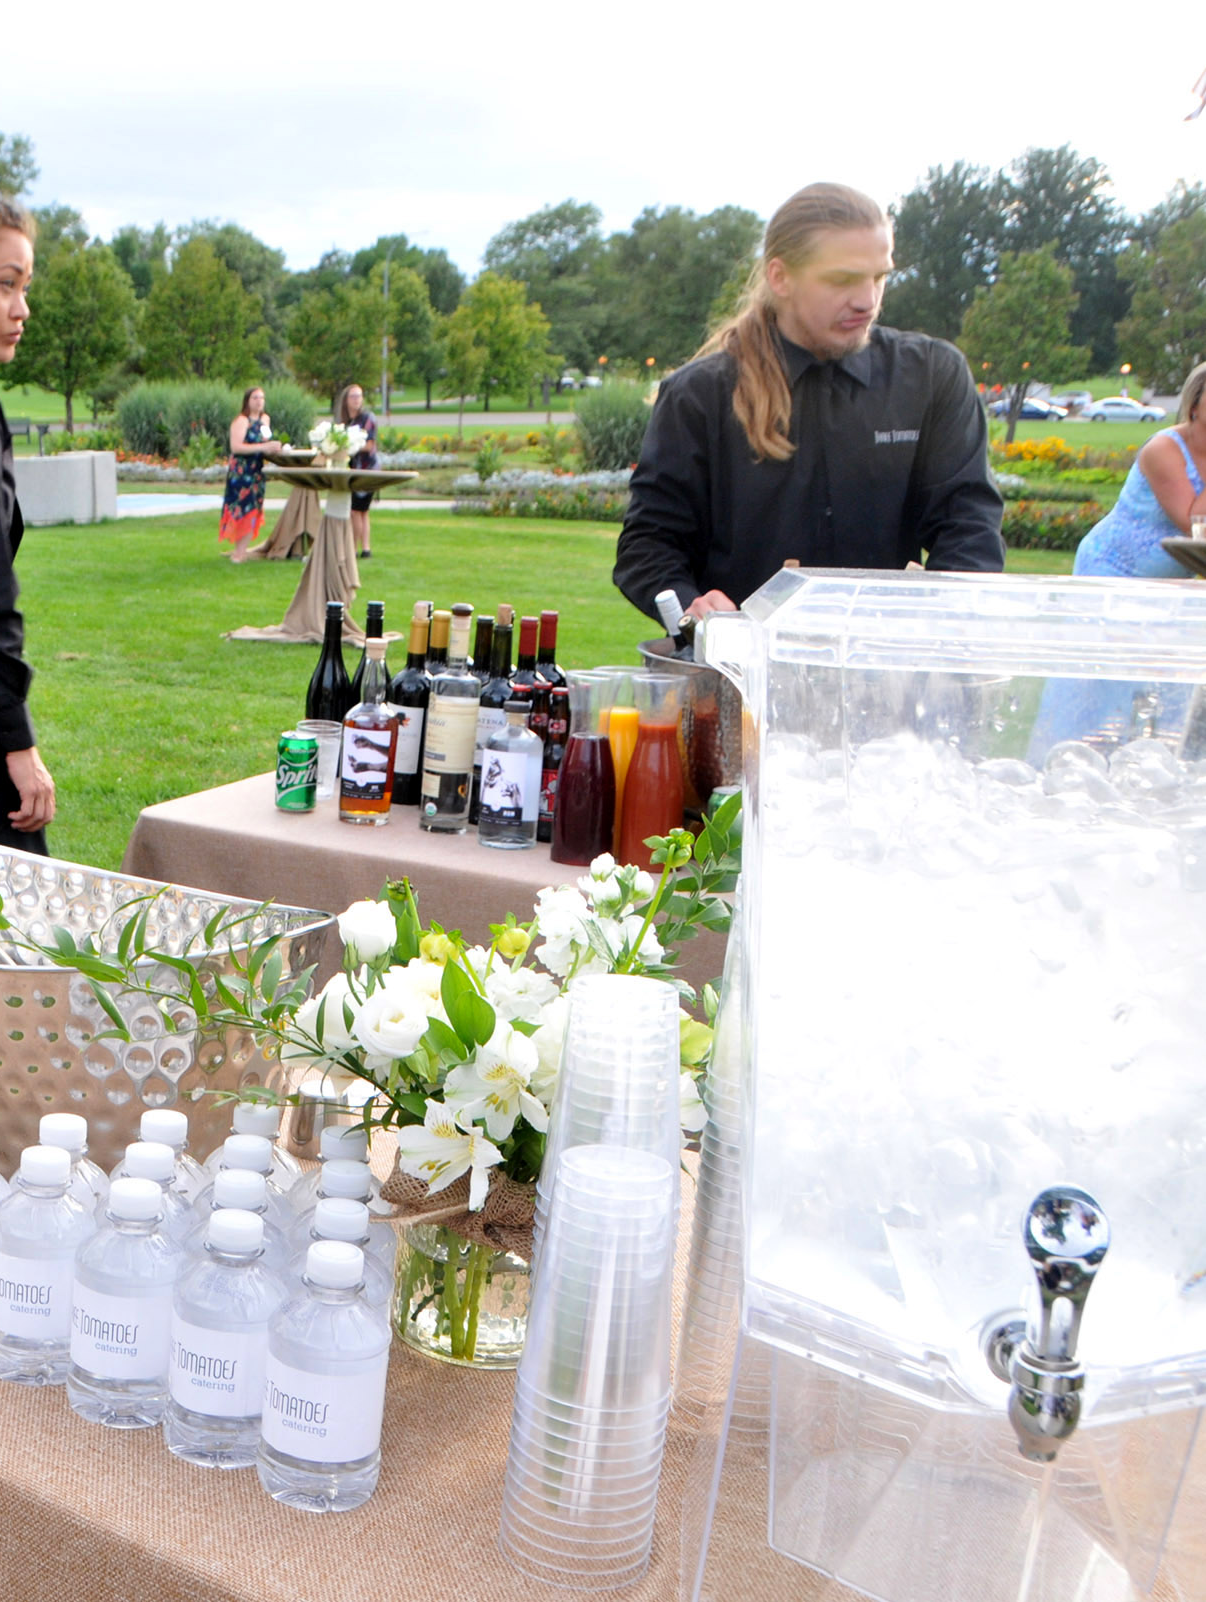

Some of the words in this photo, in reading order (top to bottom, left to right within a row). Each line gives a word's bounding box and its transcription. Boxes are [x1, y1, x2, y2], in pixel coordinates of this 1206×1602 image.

[10, 1304, 51, 1317] catering
[95, 1342, 138, 1357] catering
[191, 1377, 235, 1393] catering
[282, 1418, 327, 1438] catering
